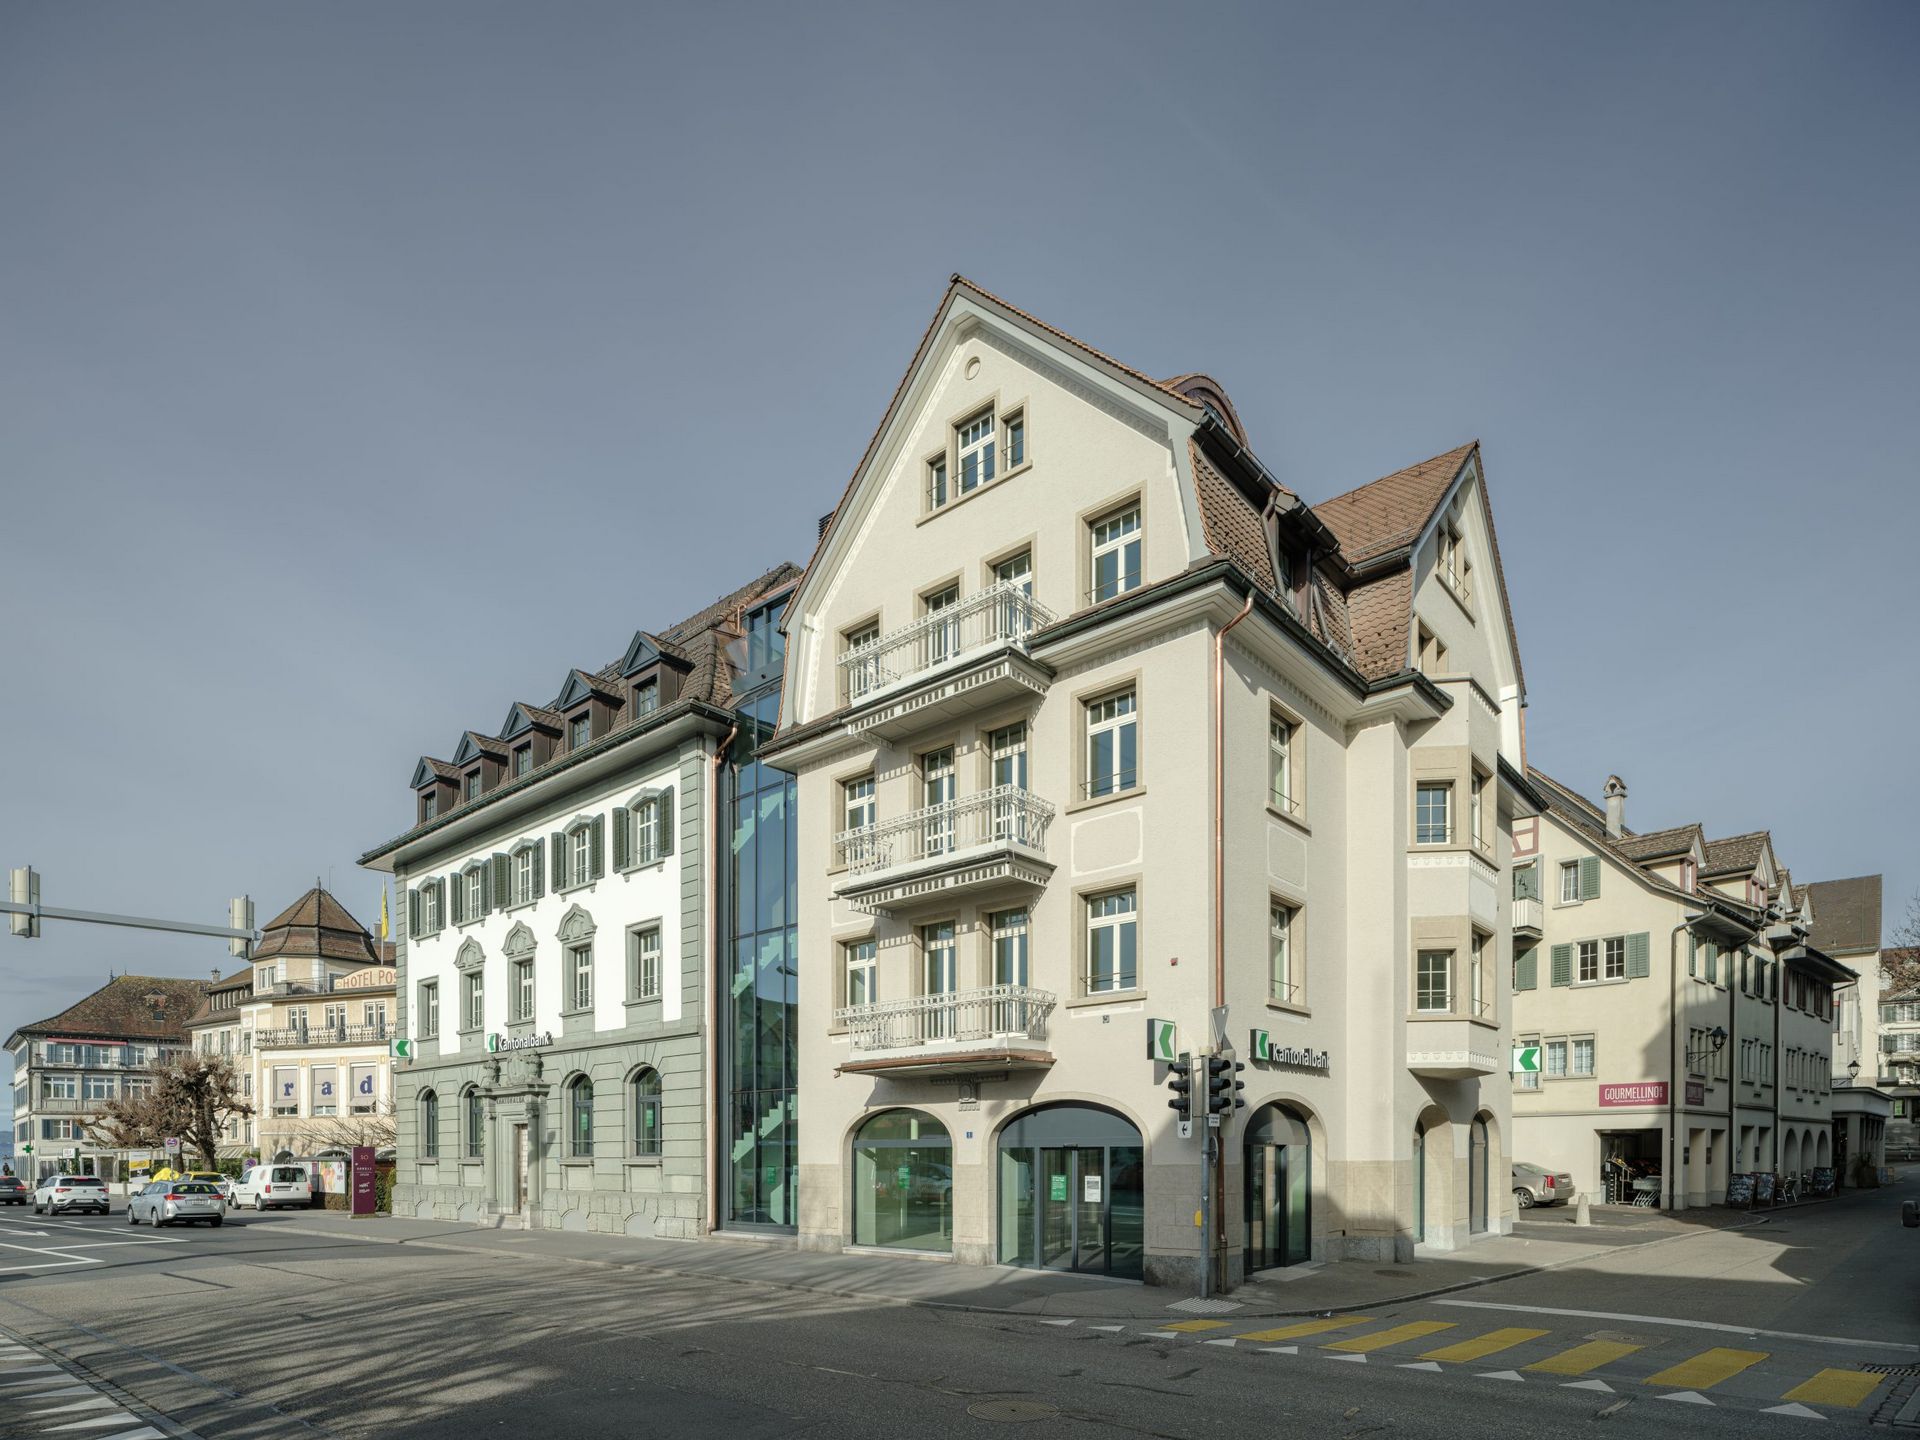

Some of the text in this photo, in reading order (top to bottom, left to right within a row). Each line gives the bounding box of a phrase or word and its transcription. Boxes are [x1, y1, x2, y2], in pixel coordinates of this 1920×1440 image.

[343, 970, 375, 988] HOTEL
[499, 1032, 549, 1052] Kantonalbank
[1604, 1085, 1659, 1100] GOURMELLINO
